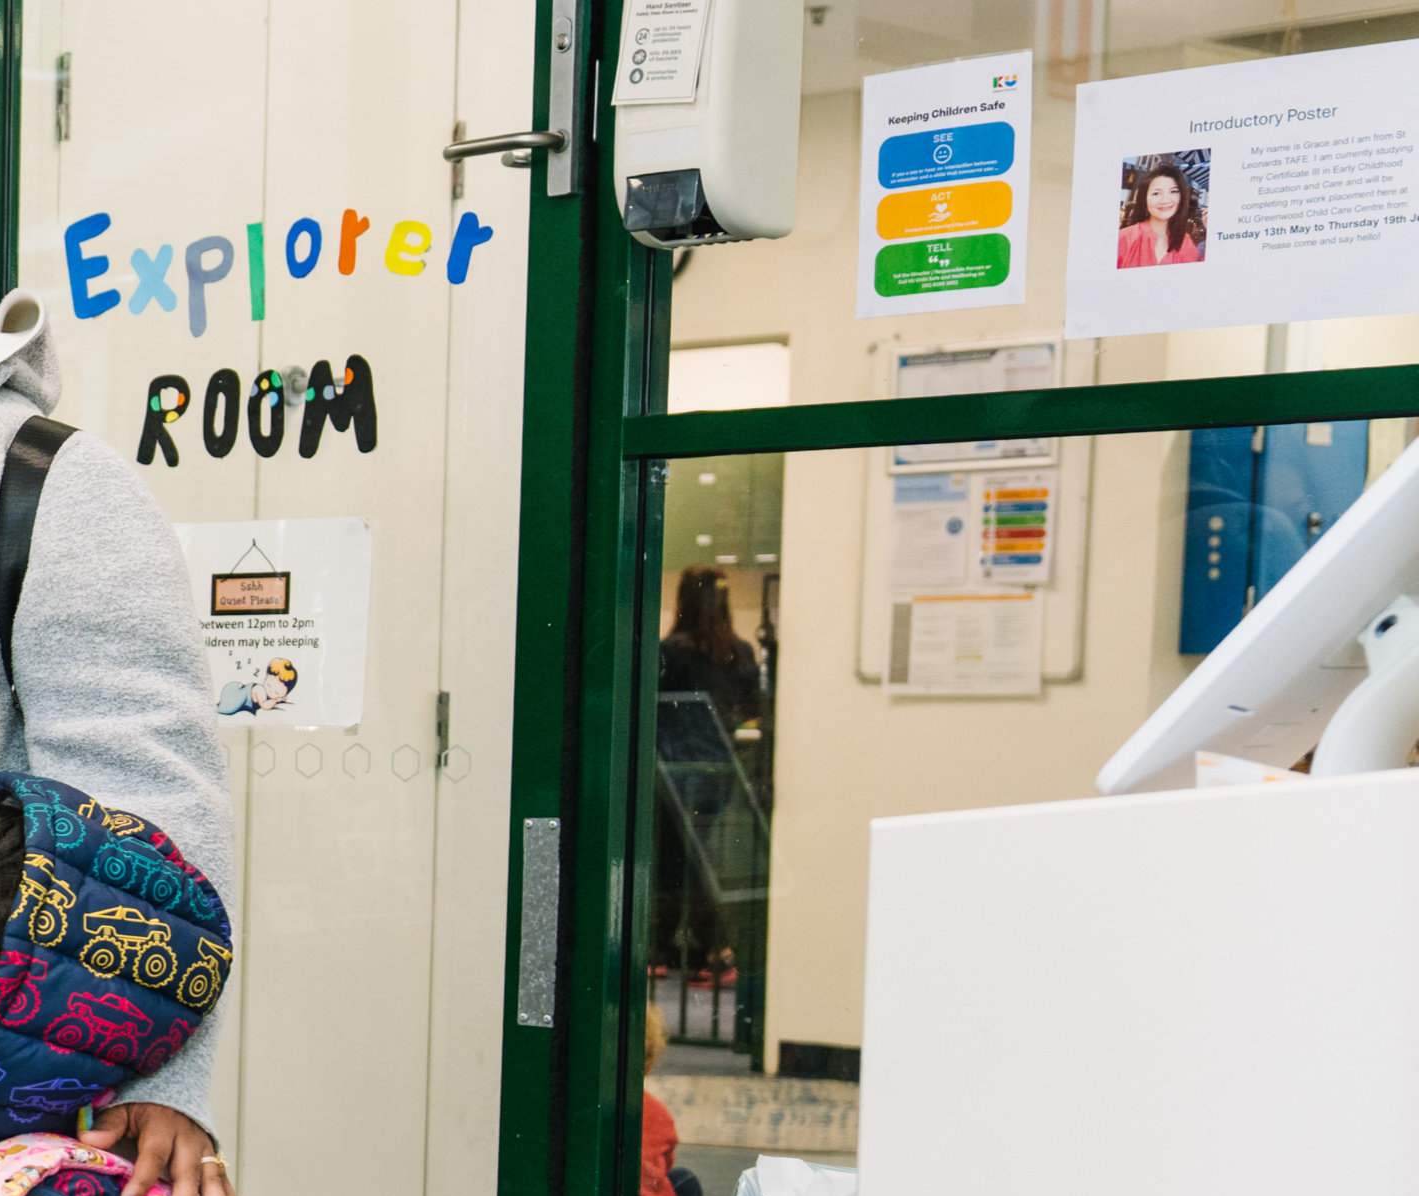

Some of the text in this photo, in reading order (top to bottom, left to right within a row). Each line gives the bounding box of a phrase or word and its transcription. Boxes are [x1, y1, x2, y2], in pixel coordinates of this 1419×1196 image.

[993, 75, 1018, 88] KU
[888, 100, 1006, 126] Keeping Children Safe
[1189, 104, 1339, 133] Introductory Poster
[933, 132, 954, 144] SEE
[1251, 130, 1407, 157] My name is Grace and I am from St
[1242, 157, 1283, 170] Leonards
[1319, 154, 1333, 162] am
[1335, 147, 1373, 160] currently
[1375, 144, 1414, 156] studying
[1250, 174, 1263, 184] my
[1265, 168, 1309, 181] Certificate
[1323, 166, 1330, 175] in
[1333, 164, 1355, 176] Early
[1357, 158, 1403, 172] Childhood
[1258, 174, 1393, 195] Education and Care and will be
[931, 191, 953, 202] ACT
[1241, 186, 1409, 212] completing my work placement here at
[1238, 215, 1251, 224] KU
[1253, 211, 1304, 224] Greenwood
[1306, 206, 1329, 218] Child
[1330, 205, 1353, 215] Care
[1354, 202, 1385, 213] Centre
[1217, 214, 1407, 241] Tuesday 13th May to Thursday 19th
[927, 242, 953, 253] TELL
[1262, 232, 1381, 250] Please come and say hello!
[65, 208, 494, 338] Explorer
[135, 354, 378, 467] ROOM
[240, 582, 264, 591] Sshh
[219, 596, 247, 606] Quiet
[247, 618, 277, 632] 12pm
[279, 618, 289, 629] to
[291, 618, 314, 631] 2pm
[205, 636, 319, 649] ildren may be sleeping
